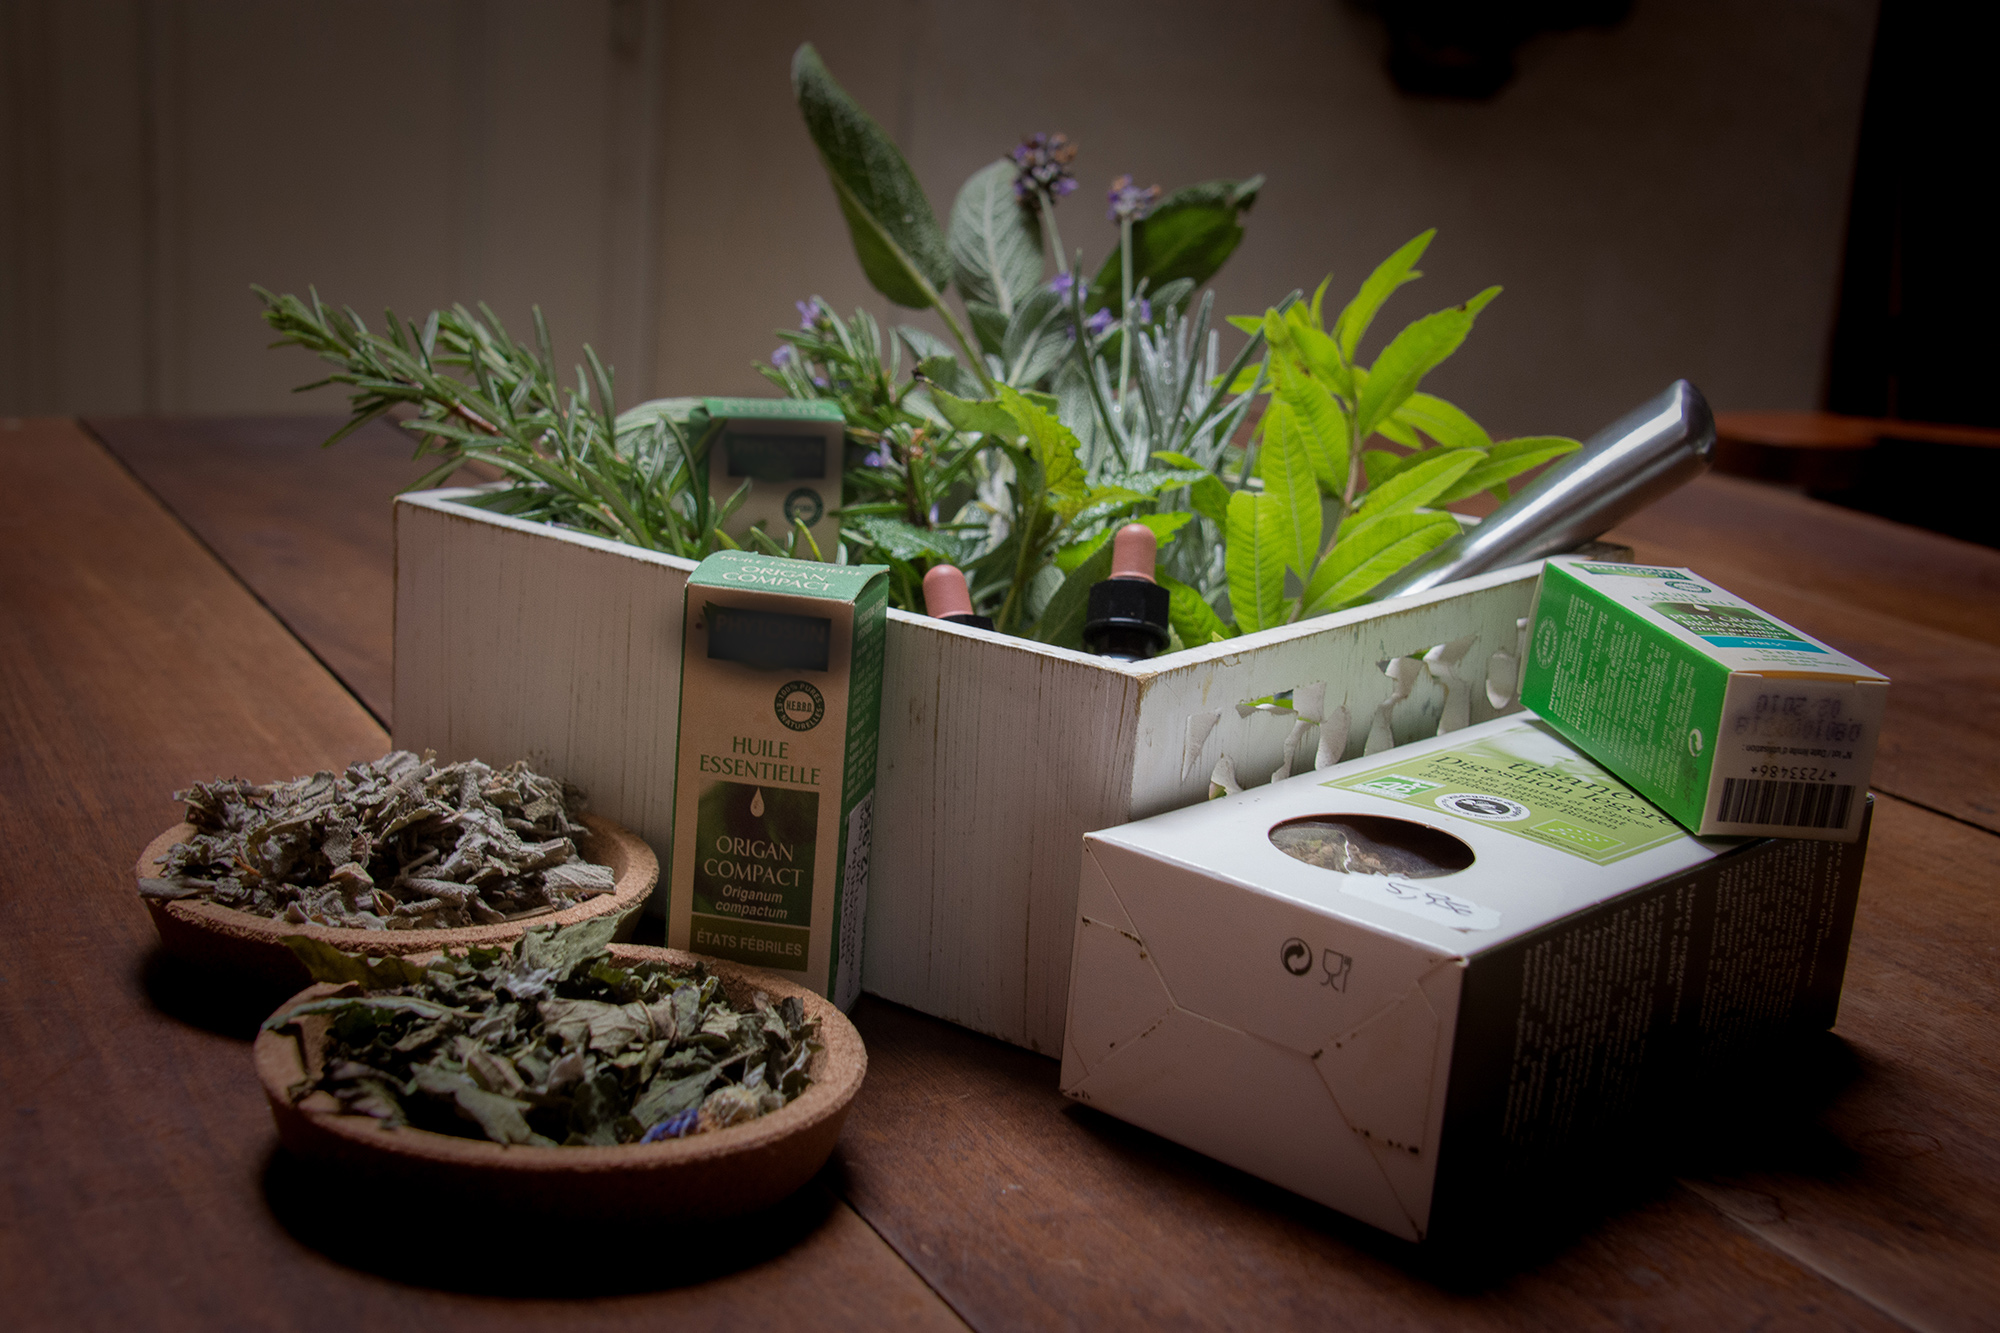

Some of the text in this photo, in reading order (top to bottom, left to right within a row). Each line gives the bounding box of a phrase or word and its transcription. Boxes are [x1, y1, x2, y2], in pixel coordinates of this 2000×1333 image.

[722, 572, 835, 591] COMPACT
[742, 566, 828, 582] ORIGAN
[800, 683, 822, 704] PURES
[781, 708, 823, 729] NATURELLES
[732, 736, 789, 759] HUILE
[1744, 745, 1787, 754] d'utilisation
[1788, 747, 1808, 755] limite
[1809, 748, 1826, 756] Date
[700, 754, 821, 786] ESSENTIELLE
[1436, 757, 1572, 794] Digestion
[1508, 763, 1635, 799] tisane
[1442, 777, 1530, 802] Hildegarde
[1559, 808, 1617, 830] Bingen
[1457, 776, 1498, 788] selon
[1504, 787, 1626, 825] l'enseignement
[1501, 782, 1563, 800] plantes
[1589, 806, 1653, 828] d'épices
[716, 836, 793, 862] ORIGAN
[704, 858, 804, 887] COMPACT
[722, 884, 783, 904] Origanum
[715, 901, 788, 919] compactum
[1673, 916, 1682, 929] la
[696, 928, 803, 956] ÉTATS FÉBRILES
[1672, 883, 1696, 1022] Notre engagement
[1667, 935, 1678, 984] qualité
